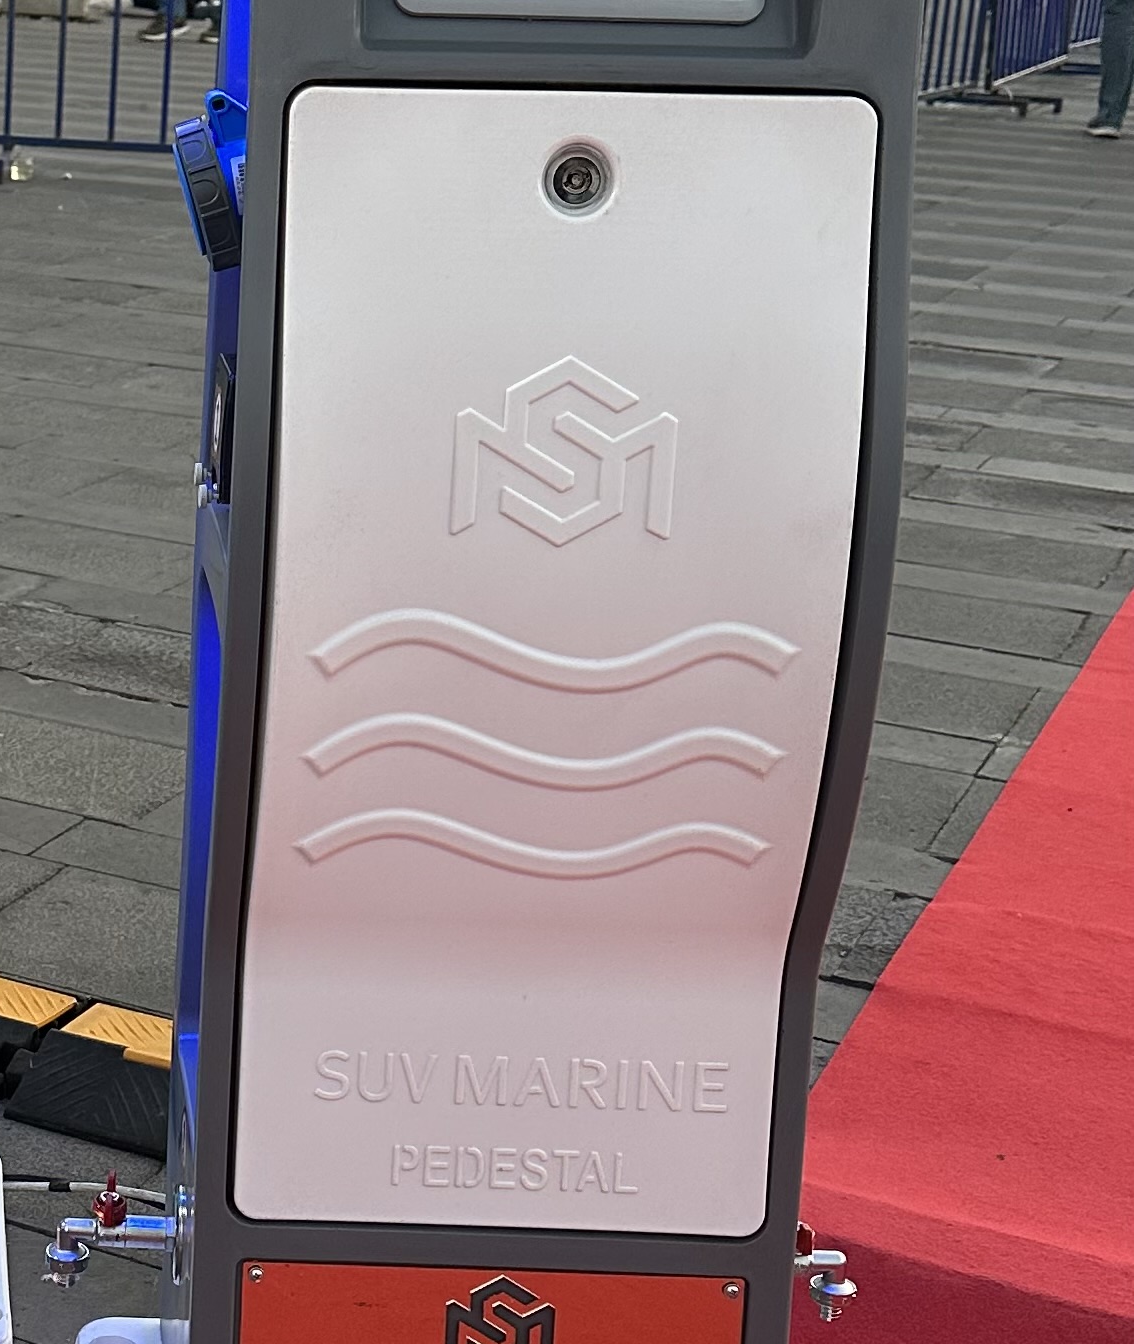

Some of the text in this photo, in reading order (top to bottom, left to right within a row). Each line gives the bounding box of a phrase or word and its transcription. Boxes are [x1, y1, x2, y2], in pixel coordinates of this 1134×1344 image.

[312, 1049, 731, 1114] SUV MARINE
[390, 1142, 639, 1195] PEDESTAL
